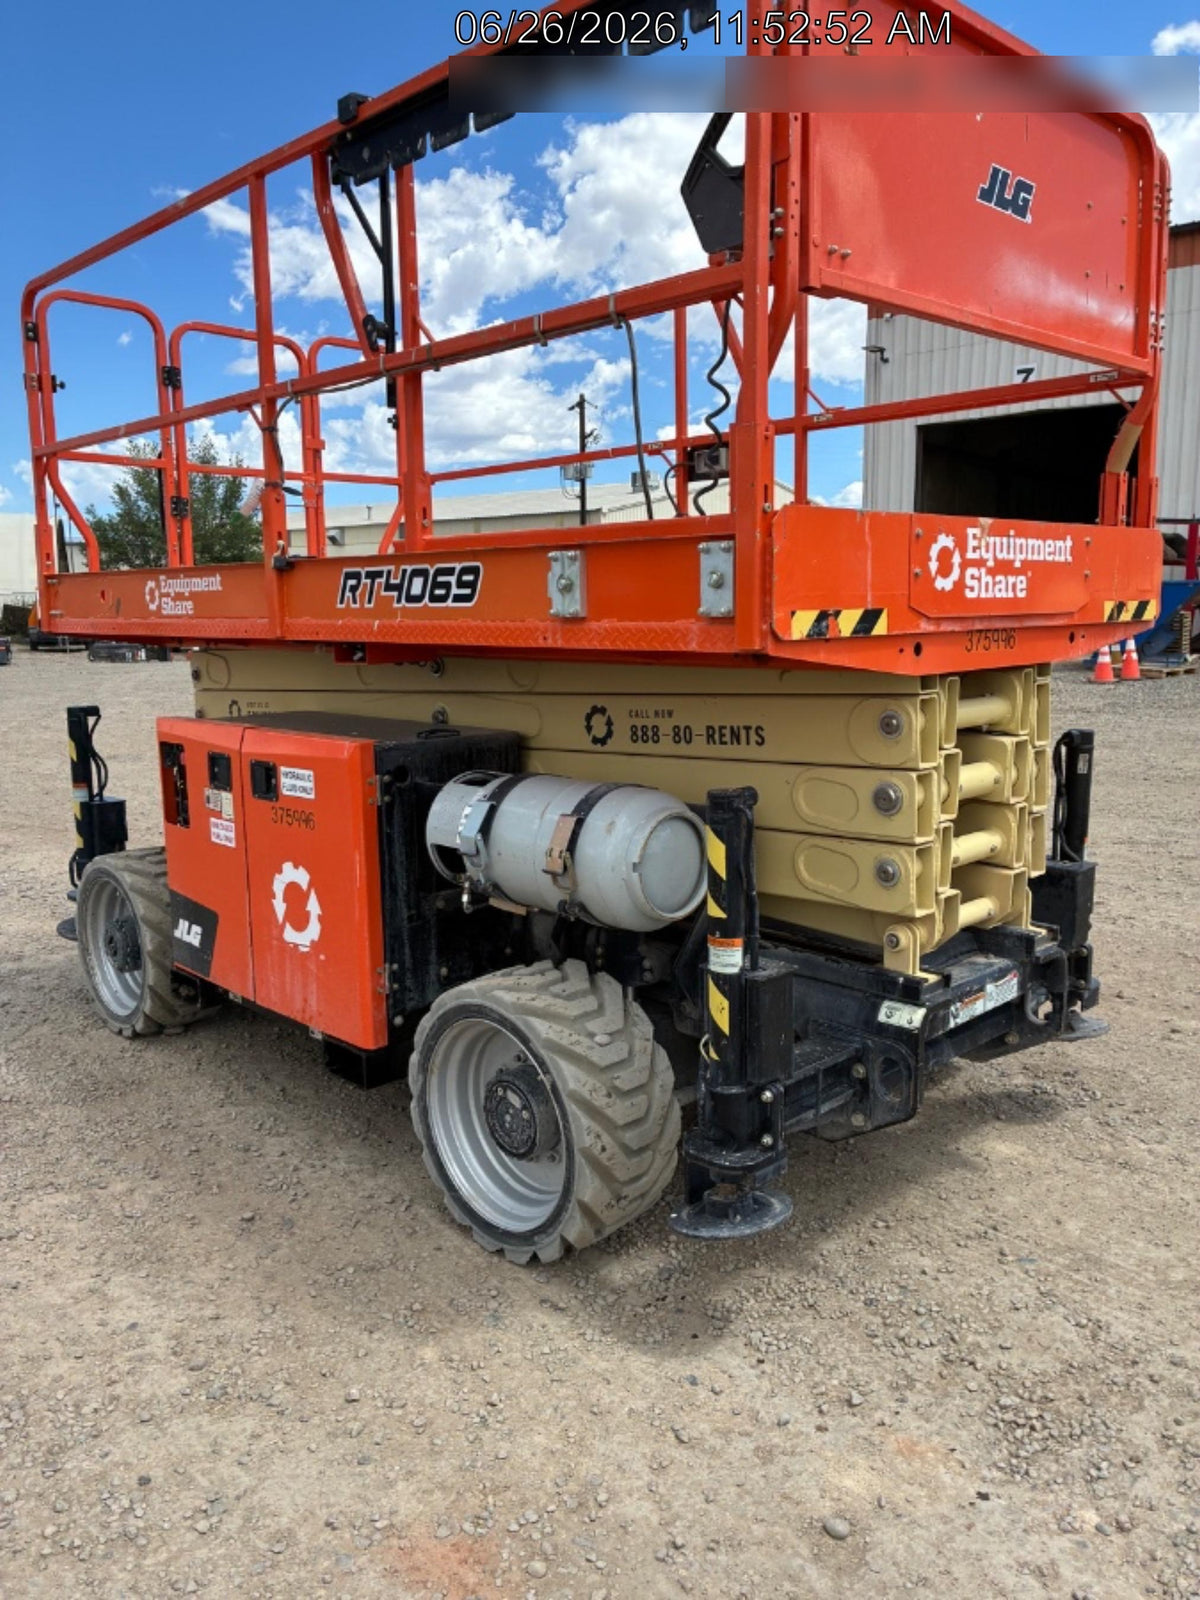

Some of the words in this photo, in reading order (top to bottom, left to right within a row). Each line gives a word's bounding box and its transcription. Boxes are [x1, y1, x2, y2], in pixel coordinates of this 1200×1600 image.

[976, 163, 1036, 223] JLG
[1016, 367, 1035, 383] 7
[965, 527, 1073, 568] Equipment
[159, 572, 223, 597] Equipment
[336, 562, 483, 608] RT4069
[964, 566, 1027, 598] Share
[161, 596, 195, 615] Share
[965, 627, 1017, 653] 375996
[628, 709, 651, 719] CALL
[653, 709, 674, 719] NOW
[629, 724, 766, 747] 888-80-RENTS
[271, 805, 316, 831] 375996
[173, 918, 203, 949] JLG
